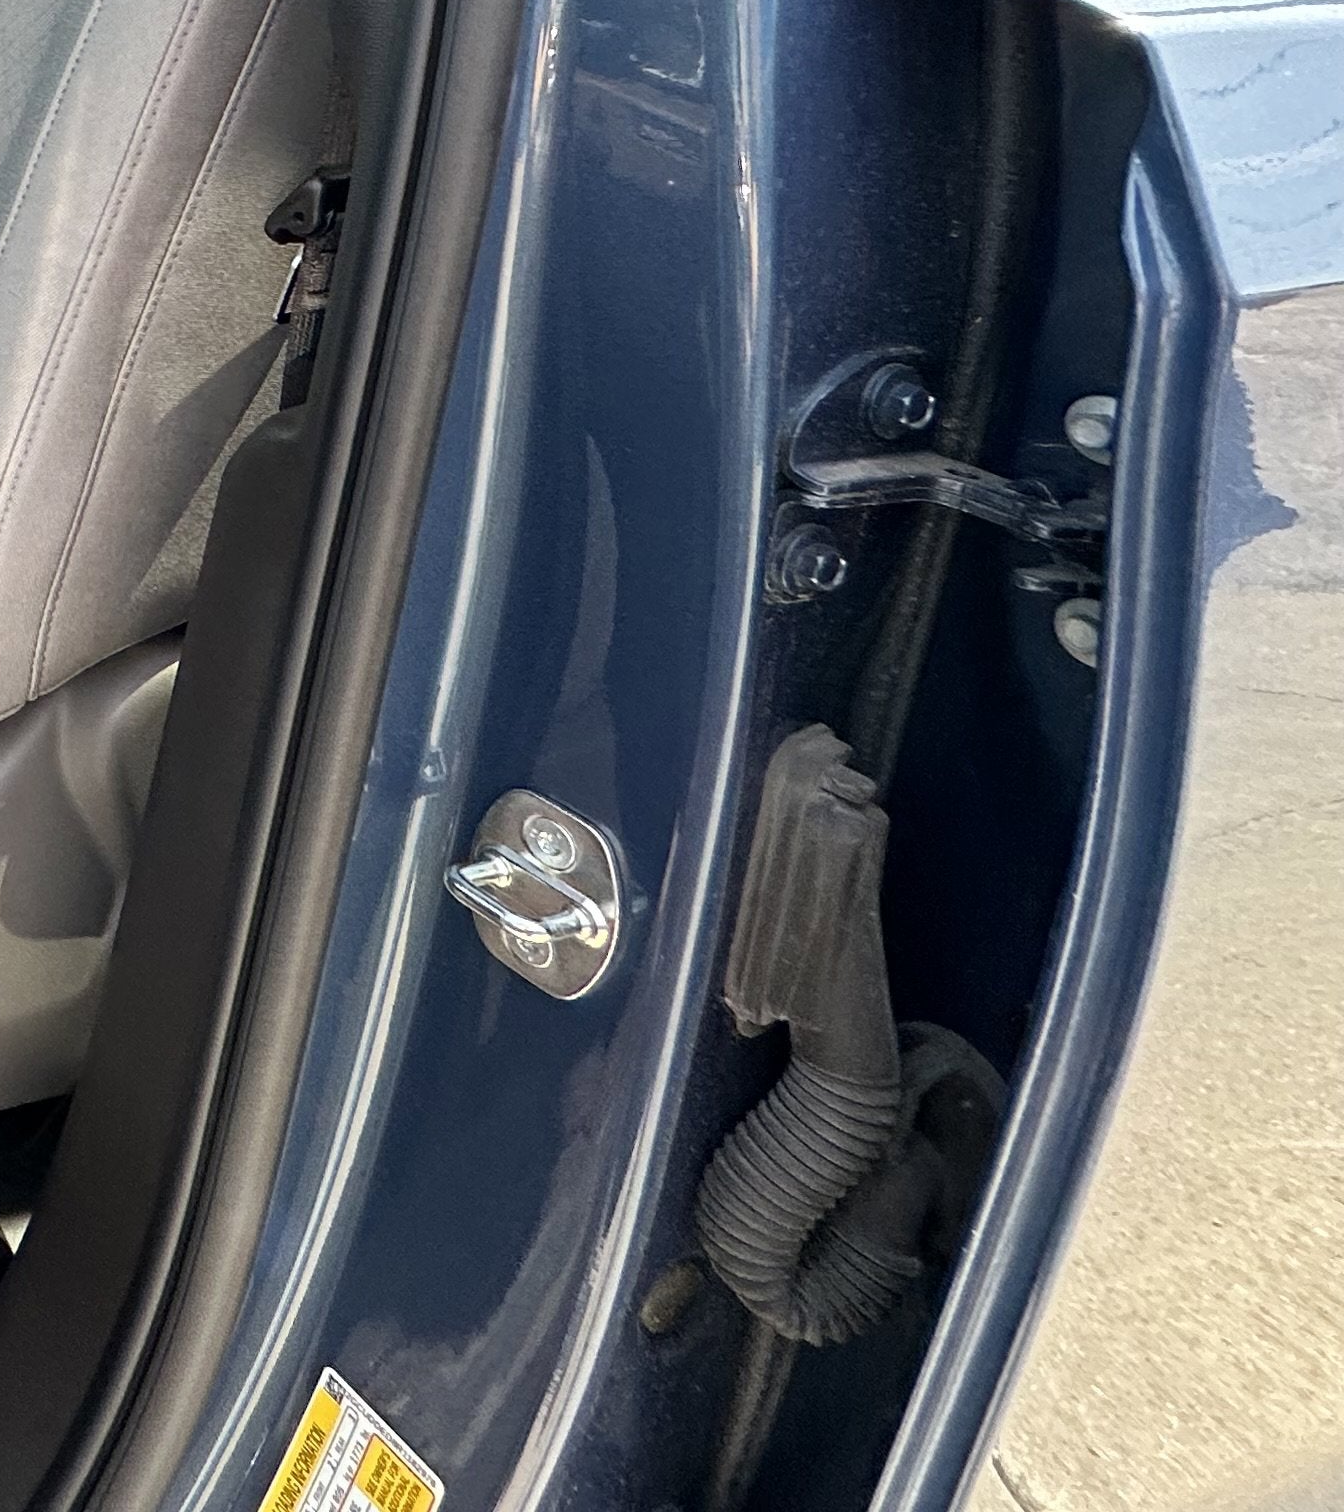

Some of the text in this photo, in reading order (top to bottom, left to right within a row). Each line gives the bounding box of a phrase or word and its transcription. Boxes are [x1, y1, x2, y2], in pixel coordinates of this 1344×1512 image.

[271, 1420, 326, 1512] OADING INFORMATION
[371, 1448, 391, 1483] OWNER'S
[375, 1460, 399, 1507] MANUAL FOR
